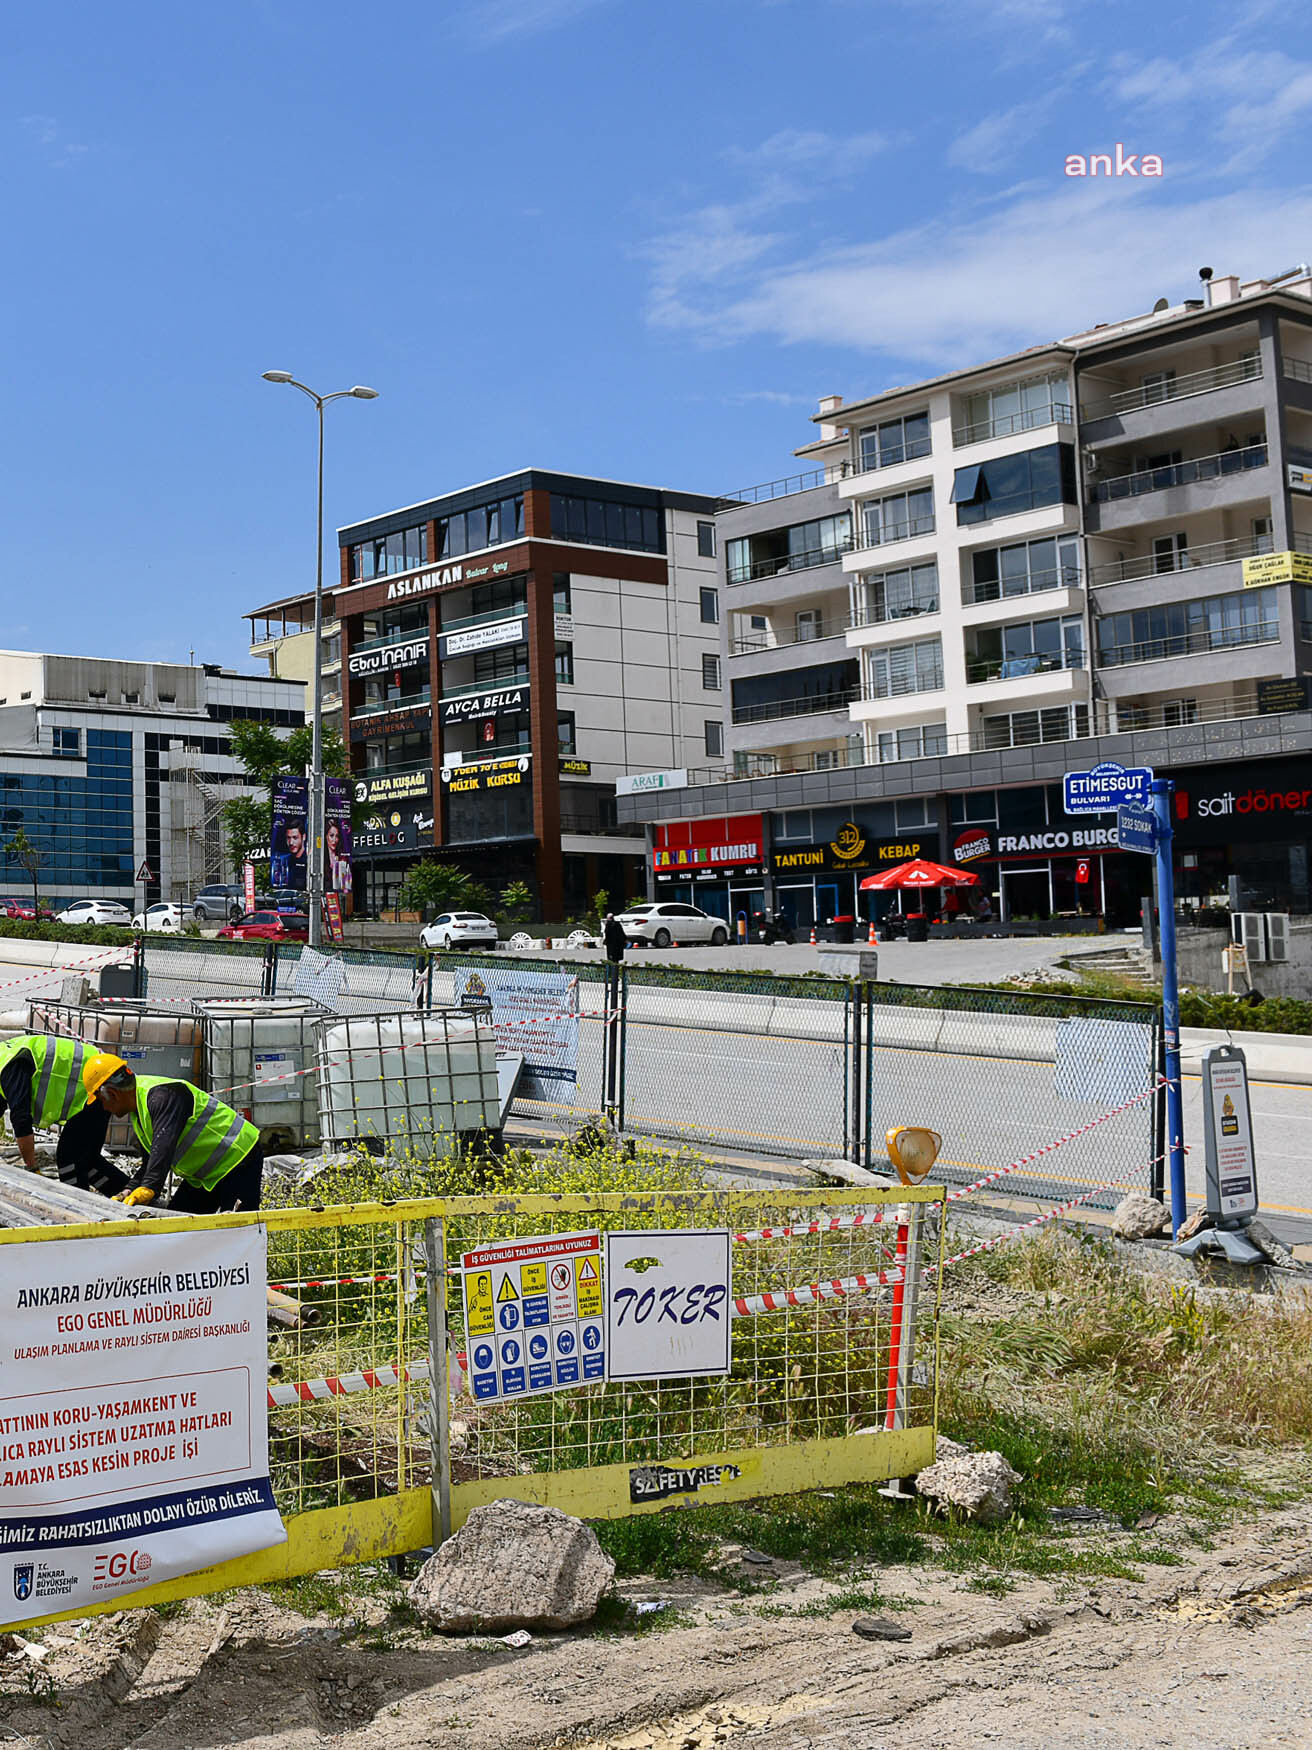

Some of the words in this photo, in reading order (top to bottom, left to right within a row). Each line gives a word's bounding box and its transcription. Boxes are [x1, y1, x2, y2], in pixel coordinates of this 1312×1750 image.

[387, 565, 462, 600] ASLANKAN
[349, 656, 380, 673] Ebru
[445, 698, 480, 716] AYCA
[483, 691, 522, 710] BELLA
[370, 778, 392, 793] ALFA
[392, 771, 426, 790] KUŞAĞI
[449, 776, 480, 793] MÜZİK
[486, 772, 521, 788] KURSU
[631, 774, 659, 788] ARAF
[1070, 775, 1144, 794] ETİMESGUT
[1070, 795, 1111, 805] BULVARI
[353, 831, 405, 848] FFEELOG
[961, 837, 989, 851] FRANCO
[998, 832, 1069, 853] FRANCO
[1072, 827, 1119, 847] BURG
[710, 843, 757, 862] KUMRU
[774, 848, 824, 868] TANTUNİ
[879, 843, 921, 860] KEBAP
[953, 843, 991, 862] BURGER
[471, 1255, 479, 1264] İŞ
[479, 1248, 515, 1263] GÜVENLİĞİ
[515, 1243, 565, 1258] TALİMATLARINA
[565, 1239, 592, 1250] UYUNUZ
[16, 1284, 80, 1309] ANKARA
[83, 1271, 173, 1301] BÜYÜKŞEHİR
[176, 1262, 250, 1292] BELEDİYESİ
[57, 1314, 84, 1333] EGO
[87, 1310, 130, 1330] GENEL
[133, 1296, 213, 1325] MÜDÜRLÜĞÜ
[613, 1284, 727, 1328] TOKER
[14, 1345, 50, 1360] ULAŞIM
[51, 1339, 100, 1356] PLANLAMA
[101, 1338, 113, 1350] VE
[114, 1334, 139, 1349] RAYLI
[140, 1329, 170, 1346] SİSTEM
[172, 1325, 202, 1343] DAİRESİ
[203, 1320, 251, 1339] BAŞKANLIĞI
[53, 1393, 178, 1428] KORU-YAŞAMKENT
[181, 1391, 197, 1407] VE
[28, 1436, 66, 1458] RAYLI
[68, 1428, 117, 1451] SİSTEM
[120, 1419, 177, 1443] UZATMA
[179, 1410, 232, 1434] HATLARI
[57, 1459, 89, 1481] ESAS
[92, 1449, 130, 1474] KESİN
[133, 1444, 176, 1467] PROJE
[182, 1436, 199, 1460] İŞİ
[38, 1512, 142, 1542] RAHATSIZLIKTAN
[143, 1503, 185, 1526] DOLAYI
[186, 1495, 217, 1517] ÖZÜR
[218, 1488, 265, 1512] DİLERİZ.
[37, 1569, 65, 1580] ANKARA
[38, 1562, 49, 1571] T.C.
[35, 1584, 71, 1597] BELEDİYESİ
[36, 1576, 79, 1588] BÜYÜKŞEHİR
